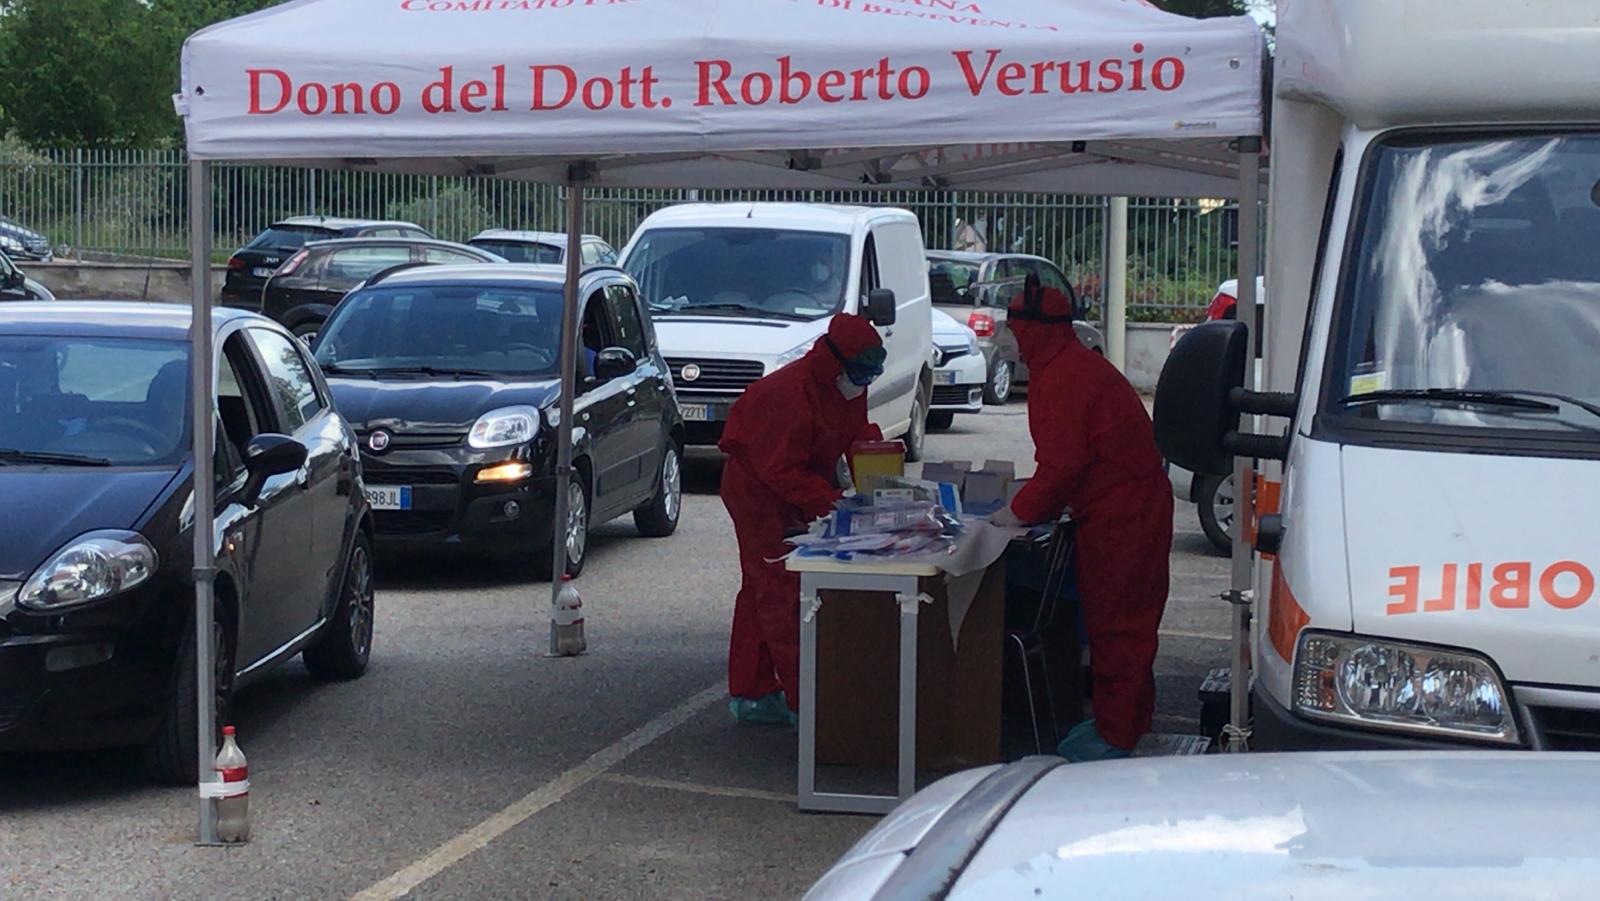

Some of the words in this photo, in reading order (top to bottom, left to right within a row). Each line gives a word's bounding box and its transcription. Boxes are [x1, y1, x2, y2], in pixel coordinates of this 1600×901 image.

[245, 67, 401, 115] Dono
[421, 64, 508, 113] del
[530, 63, 672, 111] Dott.
[694, 55, 931, 107] Roberto
[953, 42, 1186, 97] Verusio
